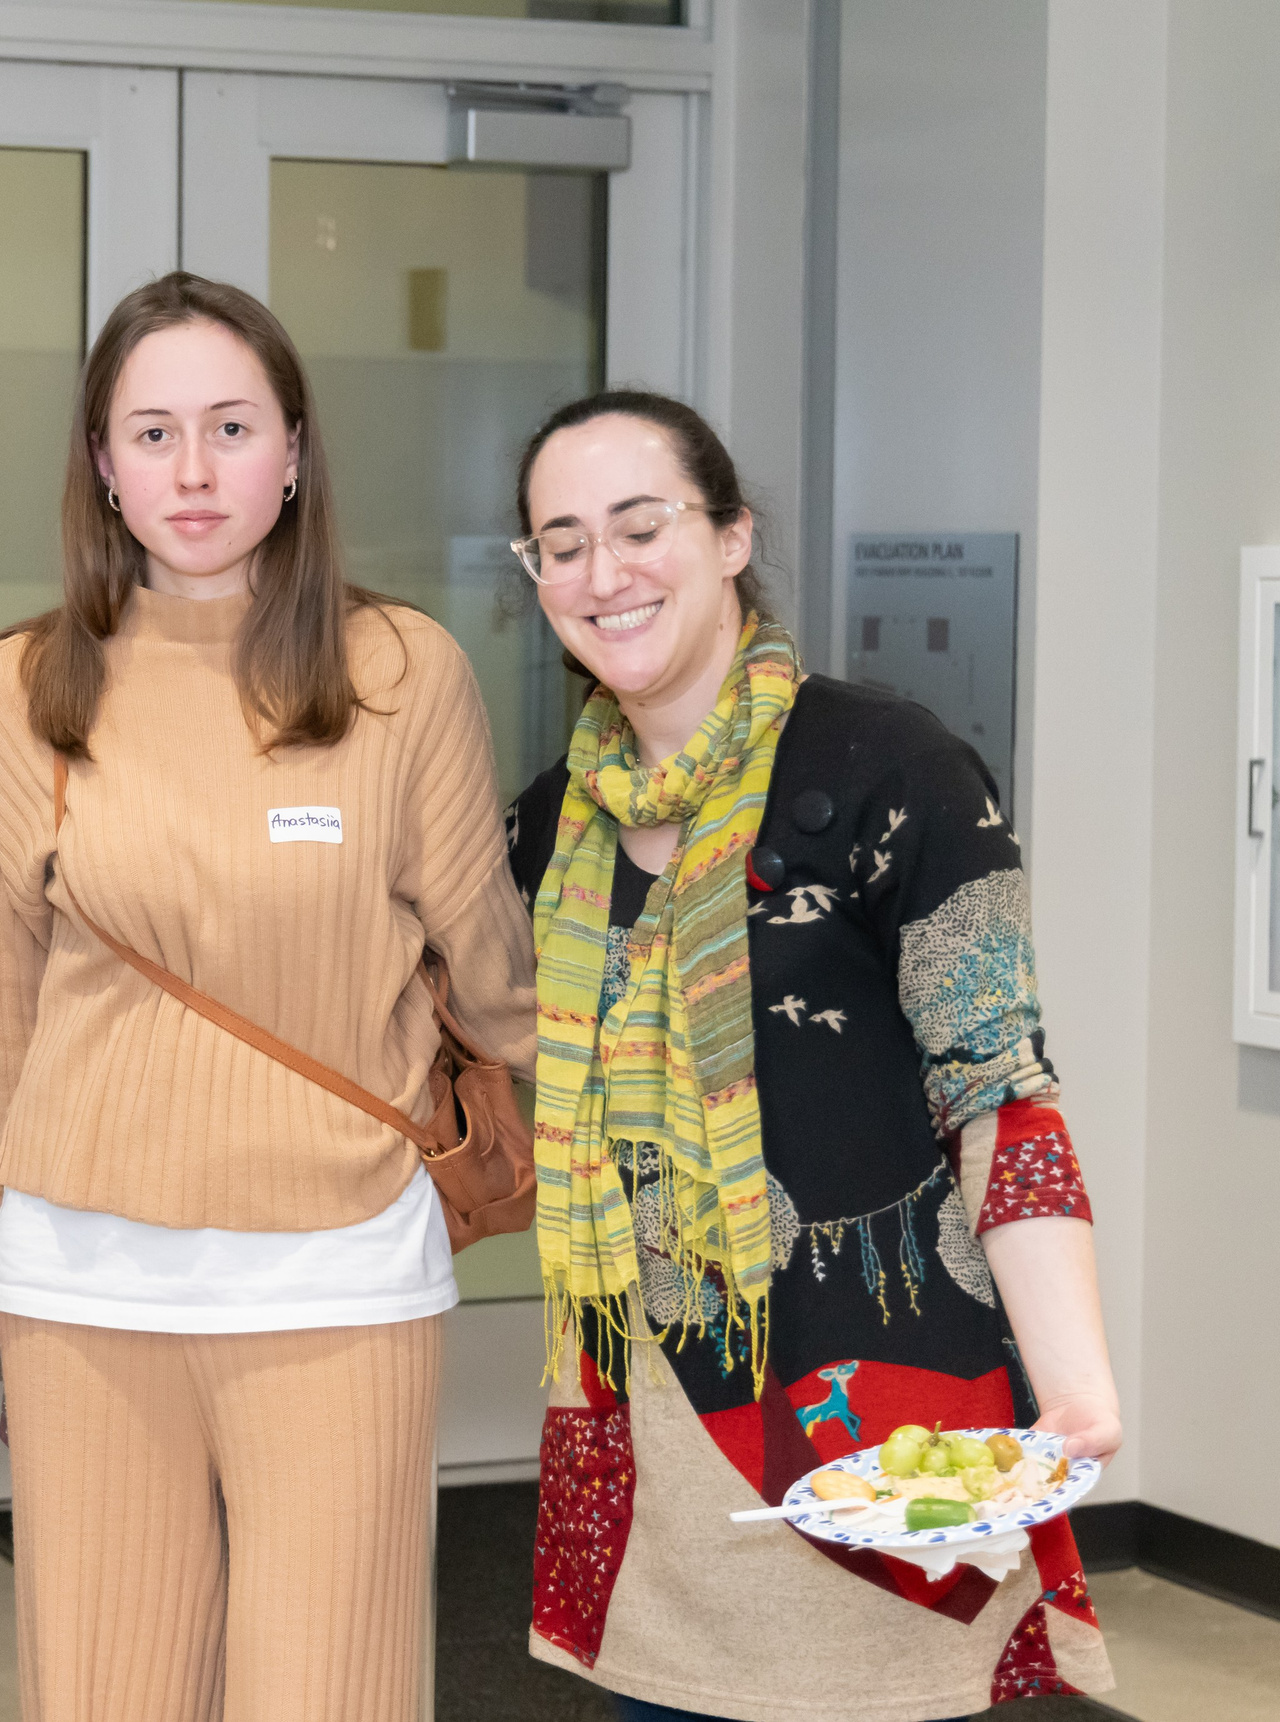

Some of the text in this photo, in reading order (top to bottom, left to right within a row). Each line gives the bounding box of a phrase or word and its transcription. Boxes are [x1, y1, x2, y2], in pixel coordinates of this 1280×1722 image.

[855, 542, 964, 560] EVACUATION PLAN
[271, 812, 341, 829] Anastasiia
